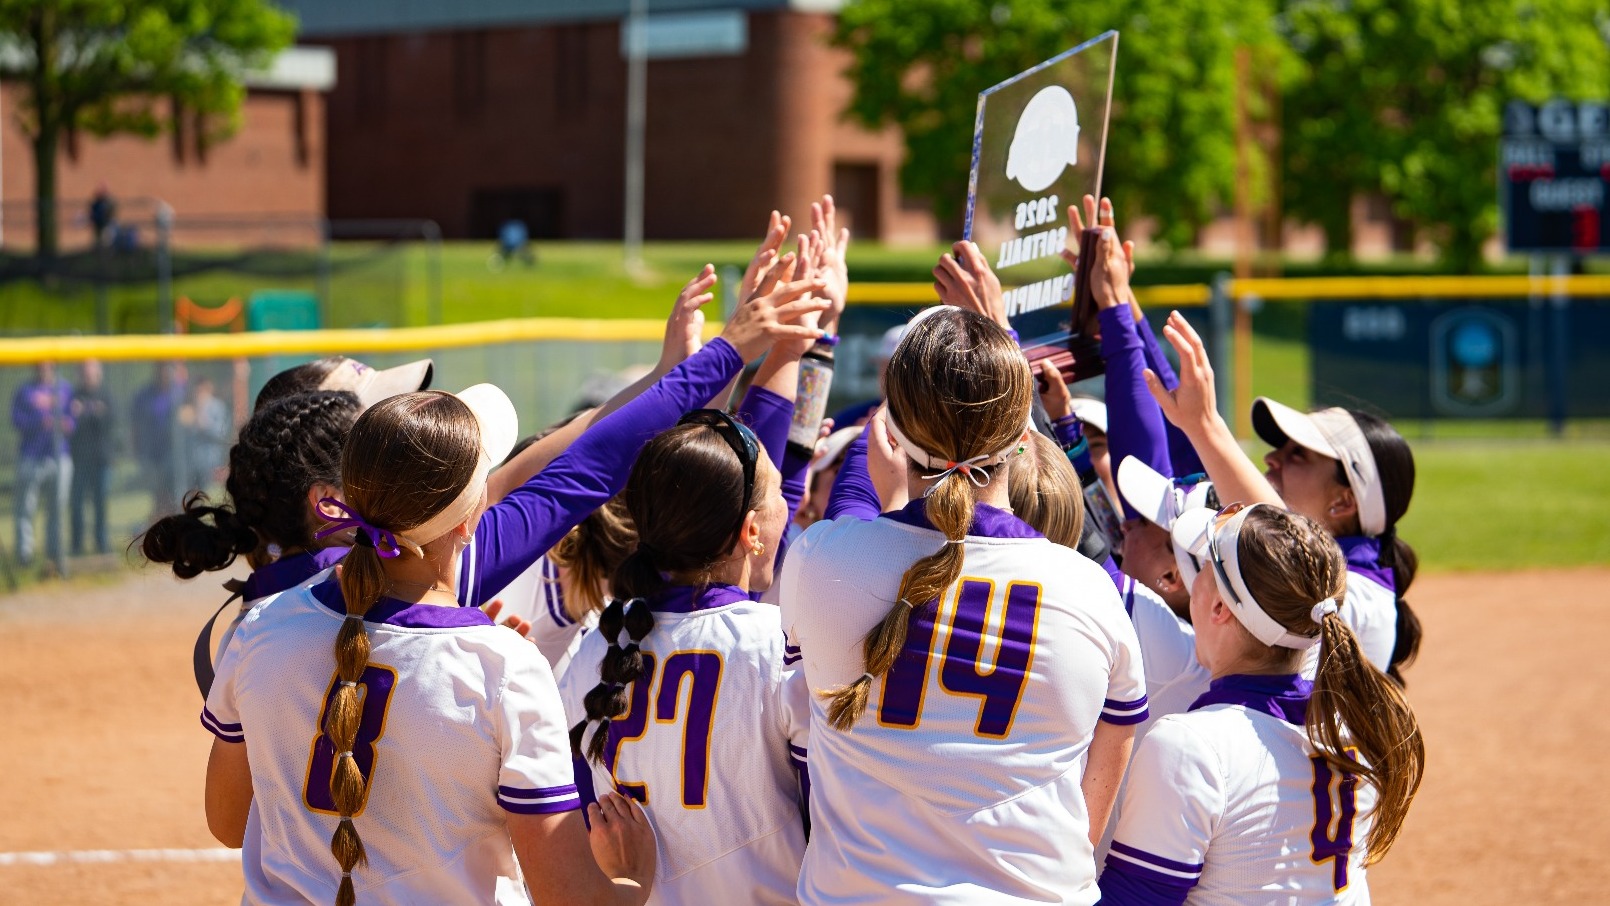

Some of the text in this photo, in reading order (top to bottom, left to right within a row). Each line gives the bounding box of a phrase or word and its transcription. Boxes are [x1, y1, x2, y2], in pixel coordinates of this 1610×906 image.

[602, 649, 724, 810] 27
[877, 569, 1043, 740] 14
[302, 662, 399, 818] 8
[1308, 746, 1359, 894] 4
